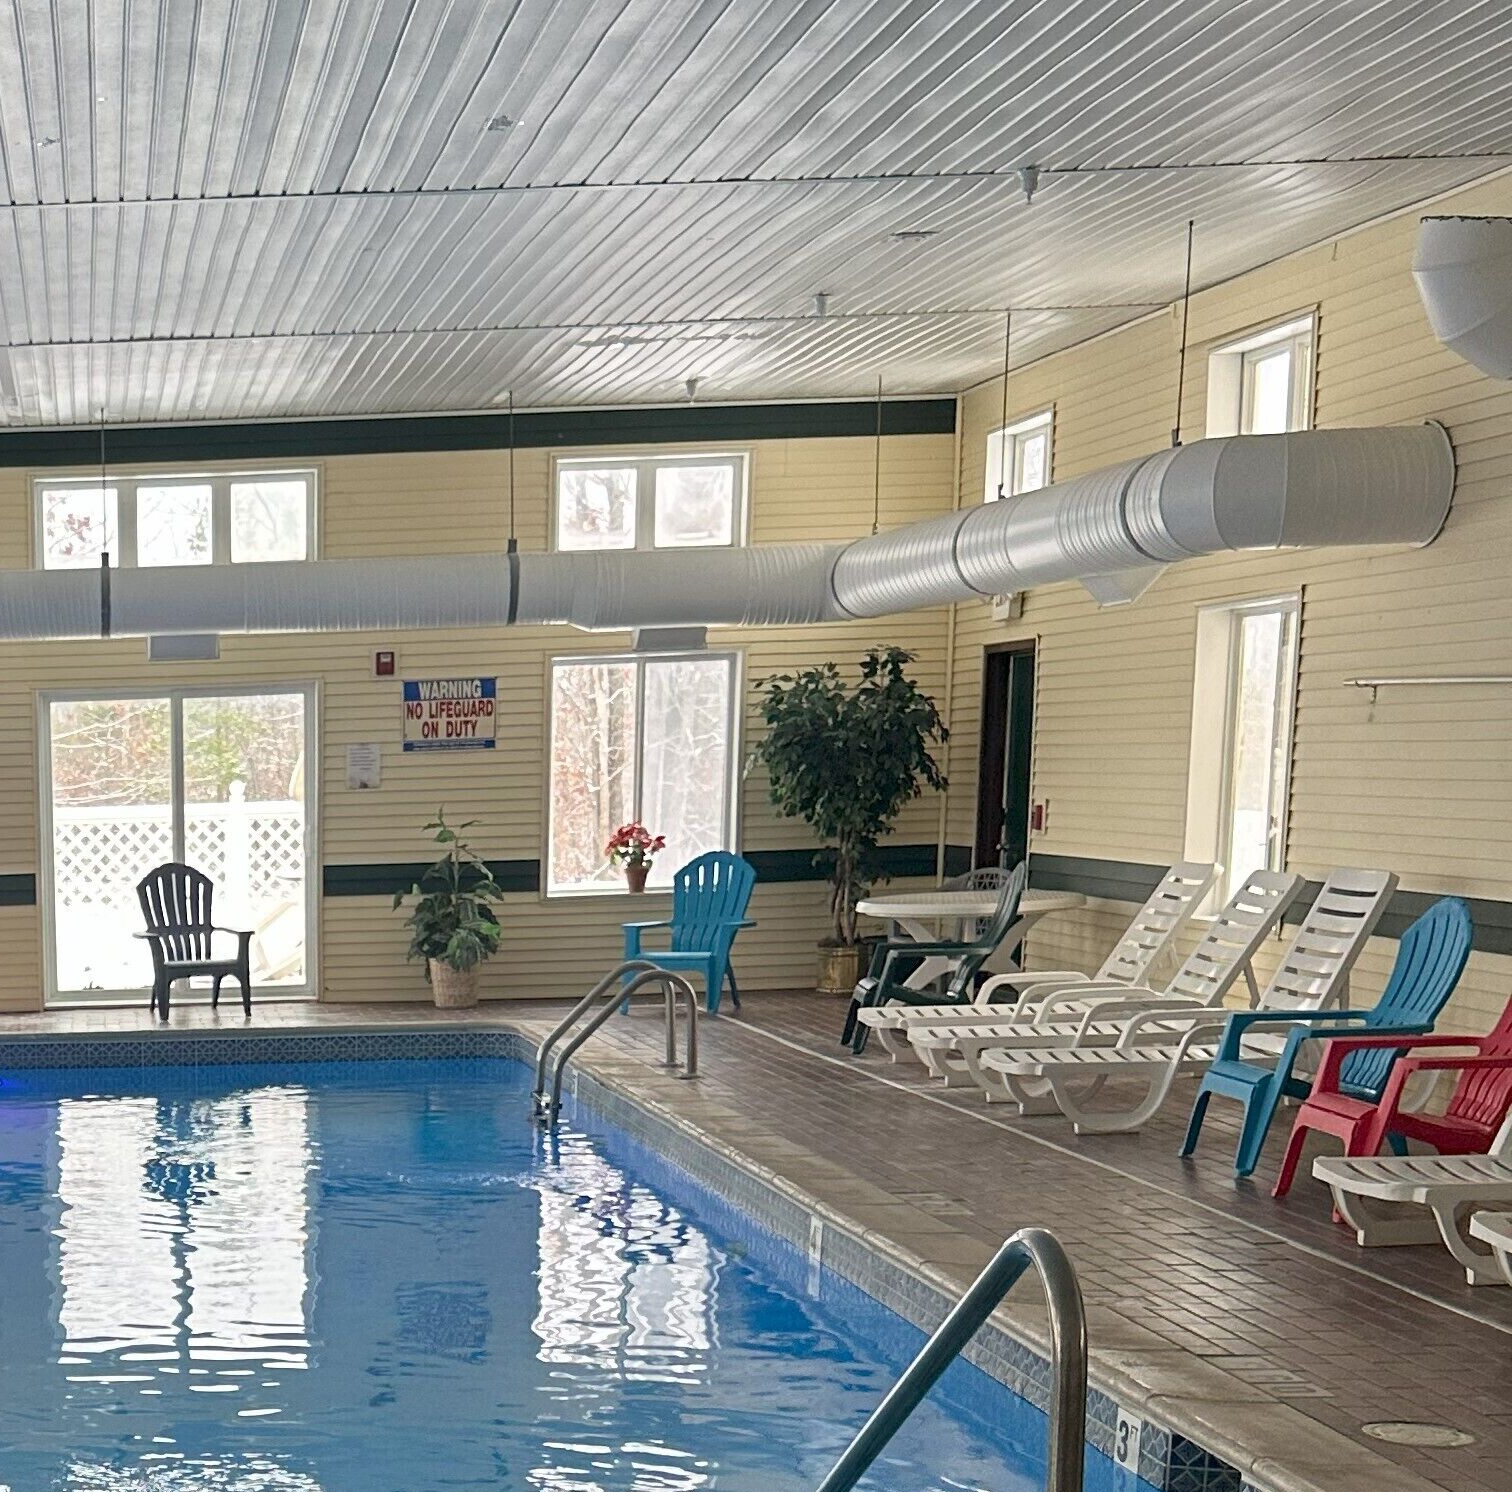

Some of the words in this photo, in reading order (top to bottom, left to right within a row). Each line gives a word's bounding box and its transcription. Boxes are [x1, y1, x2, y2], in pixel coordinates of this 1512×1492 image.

[418, 679, 482, 700] WARNING
[406, 702, 424, 720] NO
[428, 700, 494, 719] LIFEGUARD
[422, 720, 439, 739] ON
[446, 720, 478, 738] DUTY
[1116, 1420, 1129, 1462] 3
